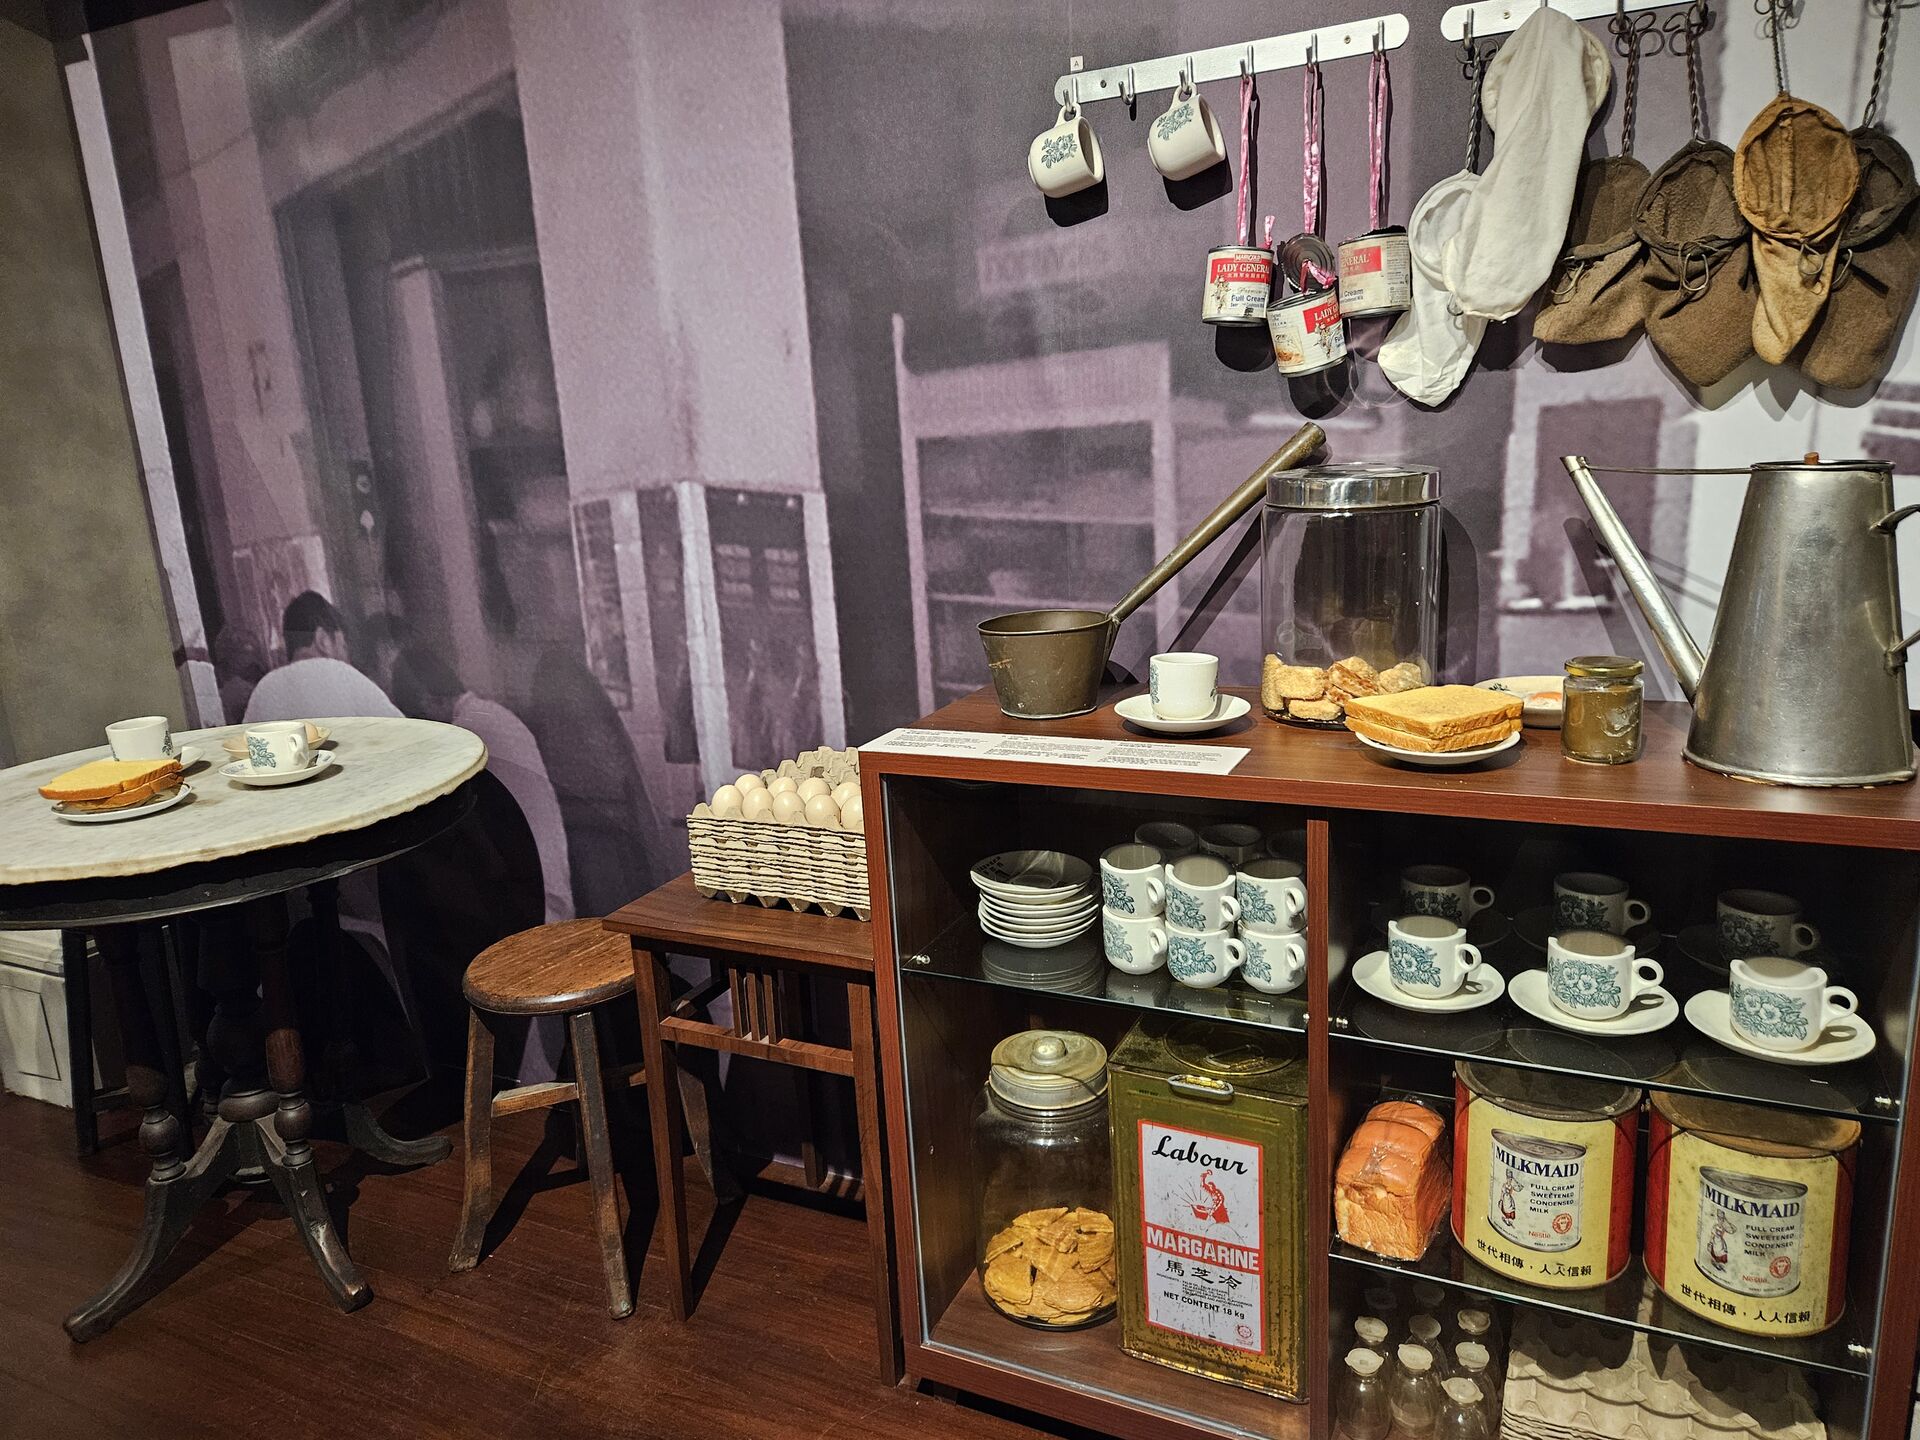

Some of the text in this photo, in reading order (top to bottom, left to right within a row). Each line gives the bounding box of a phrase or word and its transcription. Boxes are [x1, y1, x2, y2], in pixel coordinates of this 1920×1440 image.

[1217, 264, 1239, 273] LADY
[1231, 294, 1245, 302] Full
[1343, 289, 1364, 298] Cream
[1314, 305, 1333, 320] LADY
[1152, 1136, 1248, 1176] Labour
[1495, 1146, 1579, 1178] MILKMAID
[1530, 1183, 1575, 1192] FULL CREAM
[1530, 1191, 1575, 1199] SWEETENED
[1530, 1198, 1575, 1207] CONDENSED
[1705, 1184, 1800, 1219] MILKMAID
[1529, 1206, 1549, 1214] MILK
[1745, 1224, 1795, 1233] FULL CREAM
[1745, 1232, 1795, 1241] SWEETENED
[1146, 1226, 1260, 1271] MARGARINE
[1744, 1240, 1794, 1249] CONDENSED
[1743, 1249, 1765, 1257] MILK
[1163, 1290, 1245, 1320] NET CONTENT 18 kg
